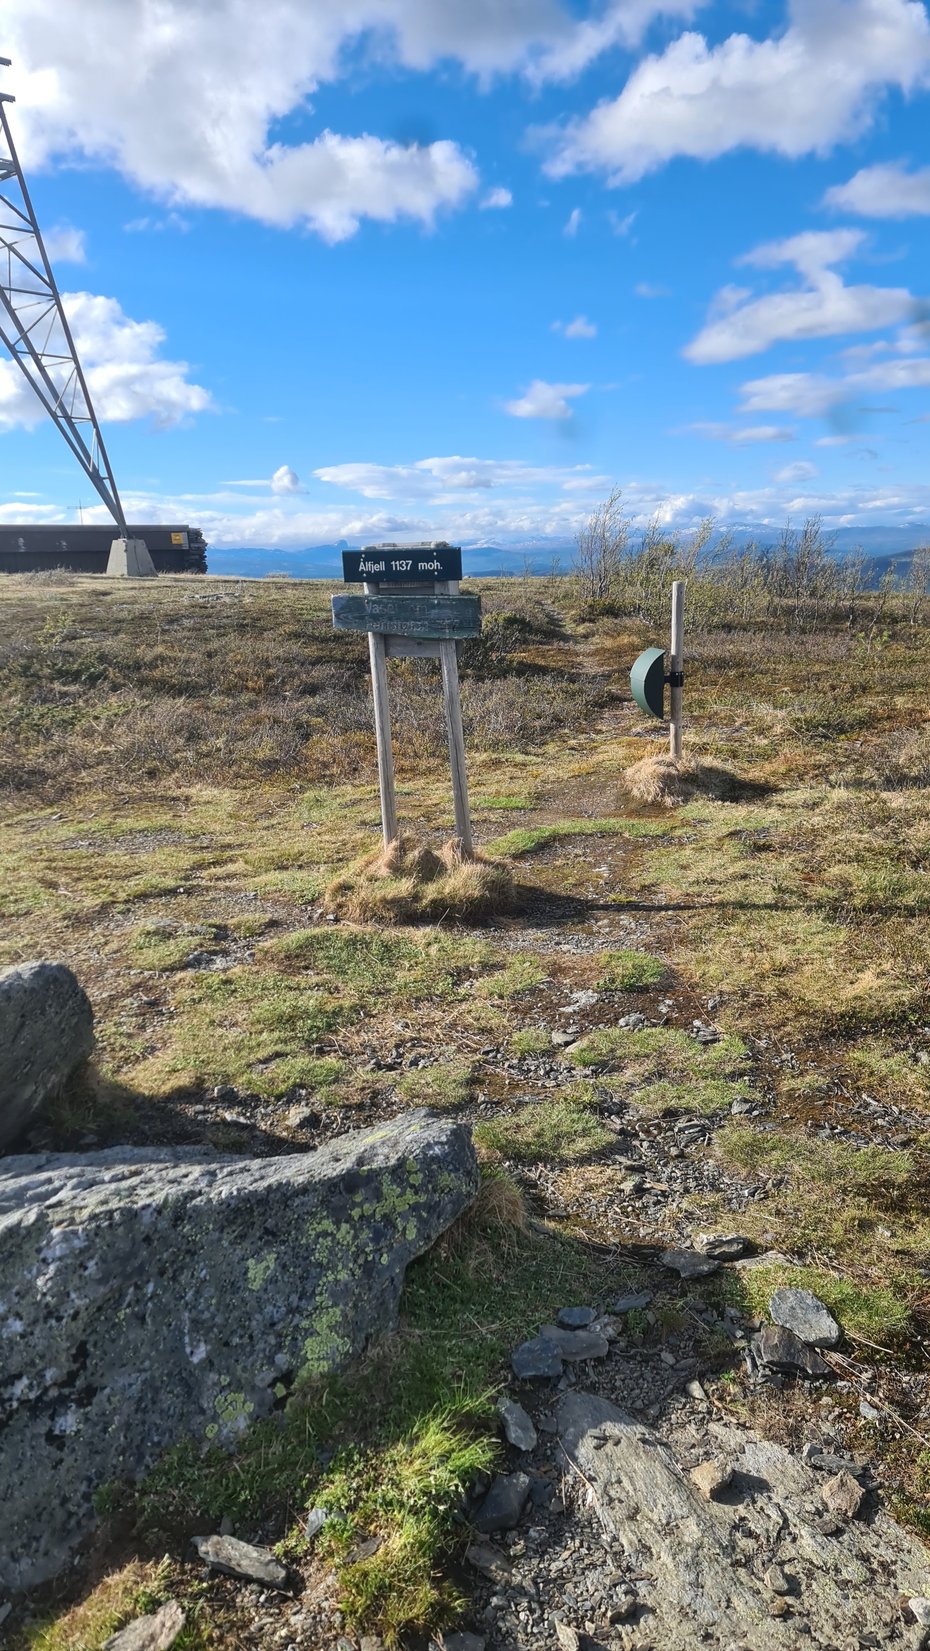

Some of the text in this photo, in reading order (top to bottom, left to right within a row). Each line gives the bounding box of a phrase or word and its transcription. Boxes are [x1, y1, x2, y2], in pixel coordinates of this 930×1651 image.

[358, 558, 443, 573] Ålfjell 1137 moh.
